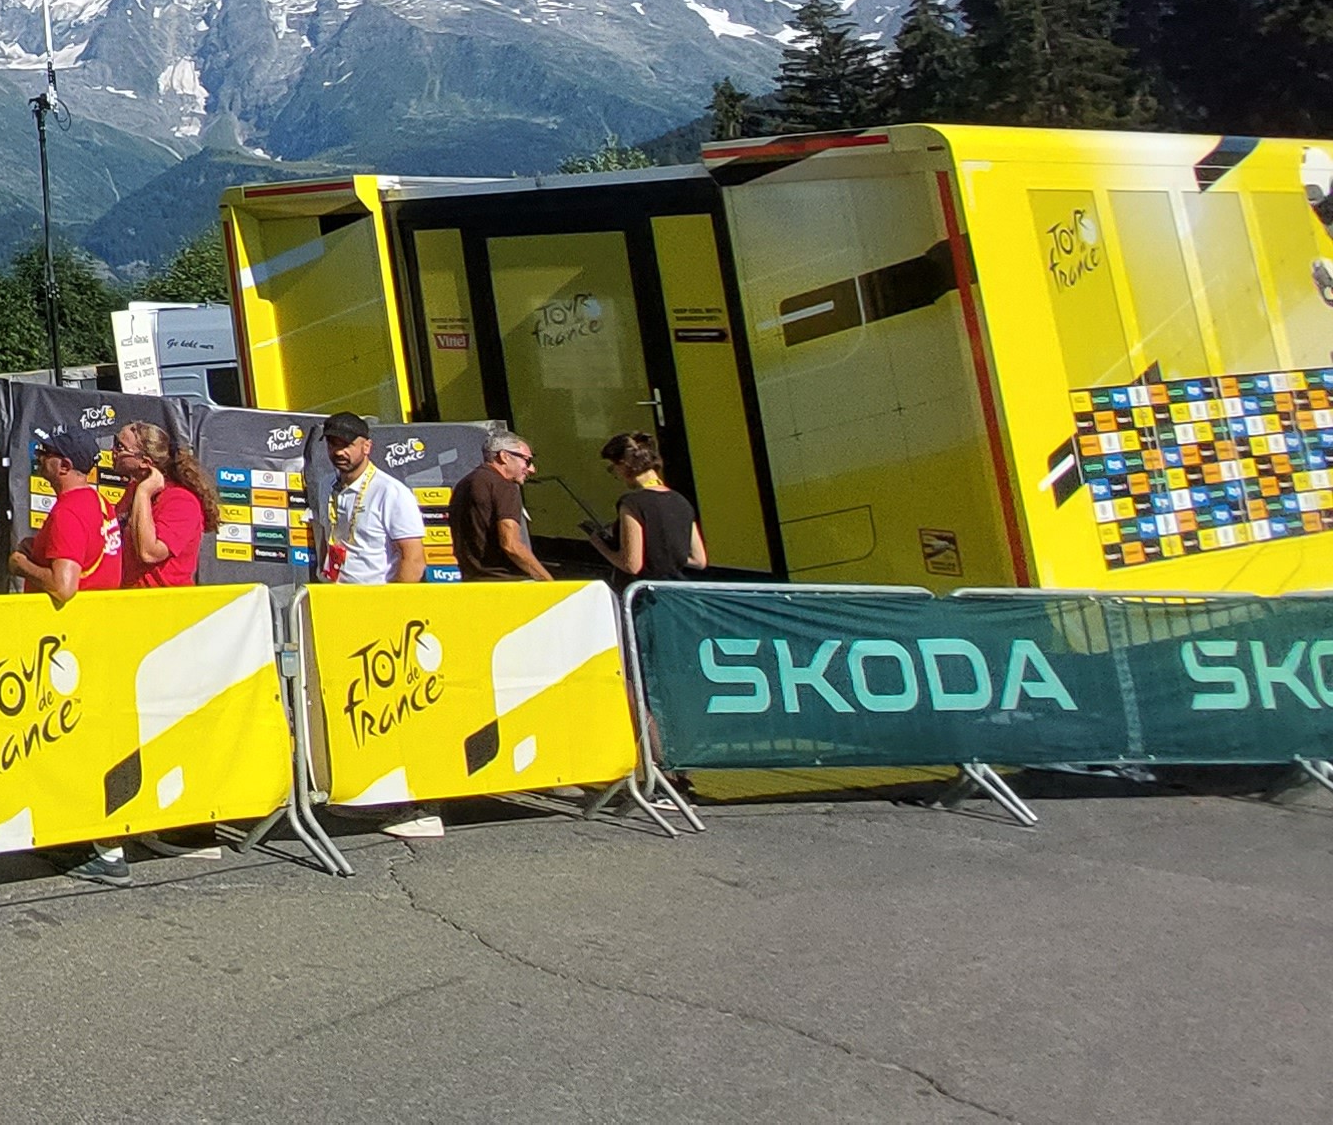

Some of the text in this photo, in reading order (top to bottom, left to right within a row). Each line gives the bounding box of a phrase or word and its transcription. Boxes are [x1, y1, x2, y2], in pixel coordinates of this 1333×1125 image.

[437, 335, 467, 347] Vittel
[220, 471, 245, 482] Krys
[256, 531, 284, 539] SKODA
[433, 569, 462, 581] Krys
[348, 618, 430, 693] TOUR
[406, 665, 420, 685] de
[37, 689, 55, 713] de
[344, 672, 445, 751] france
